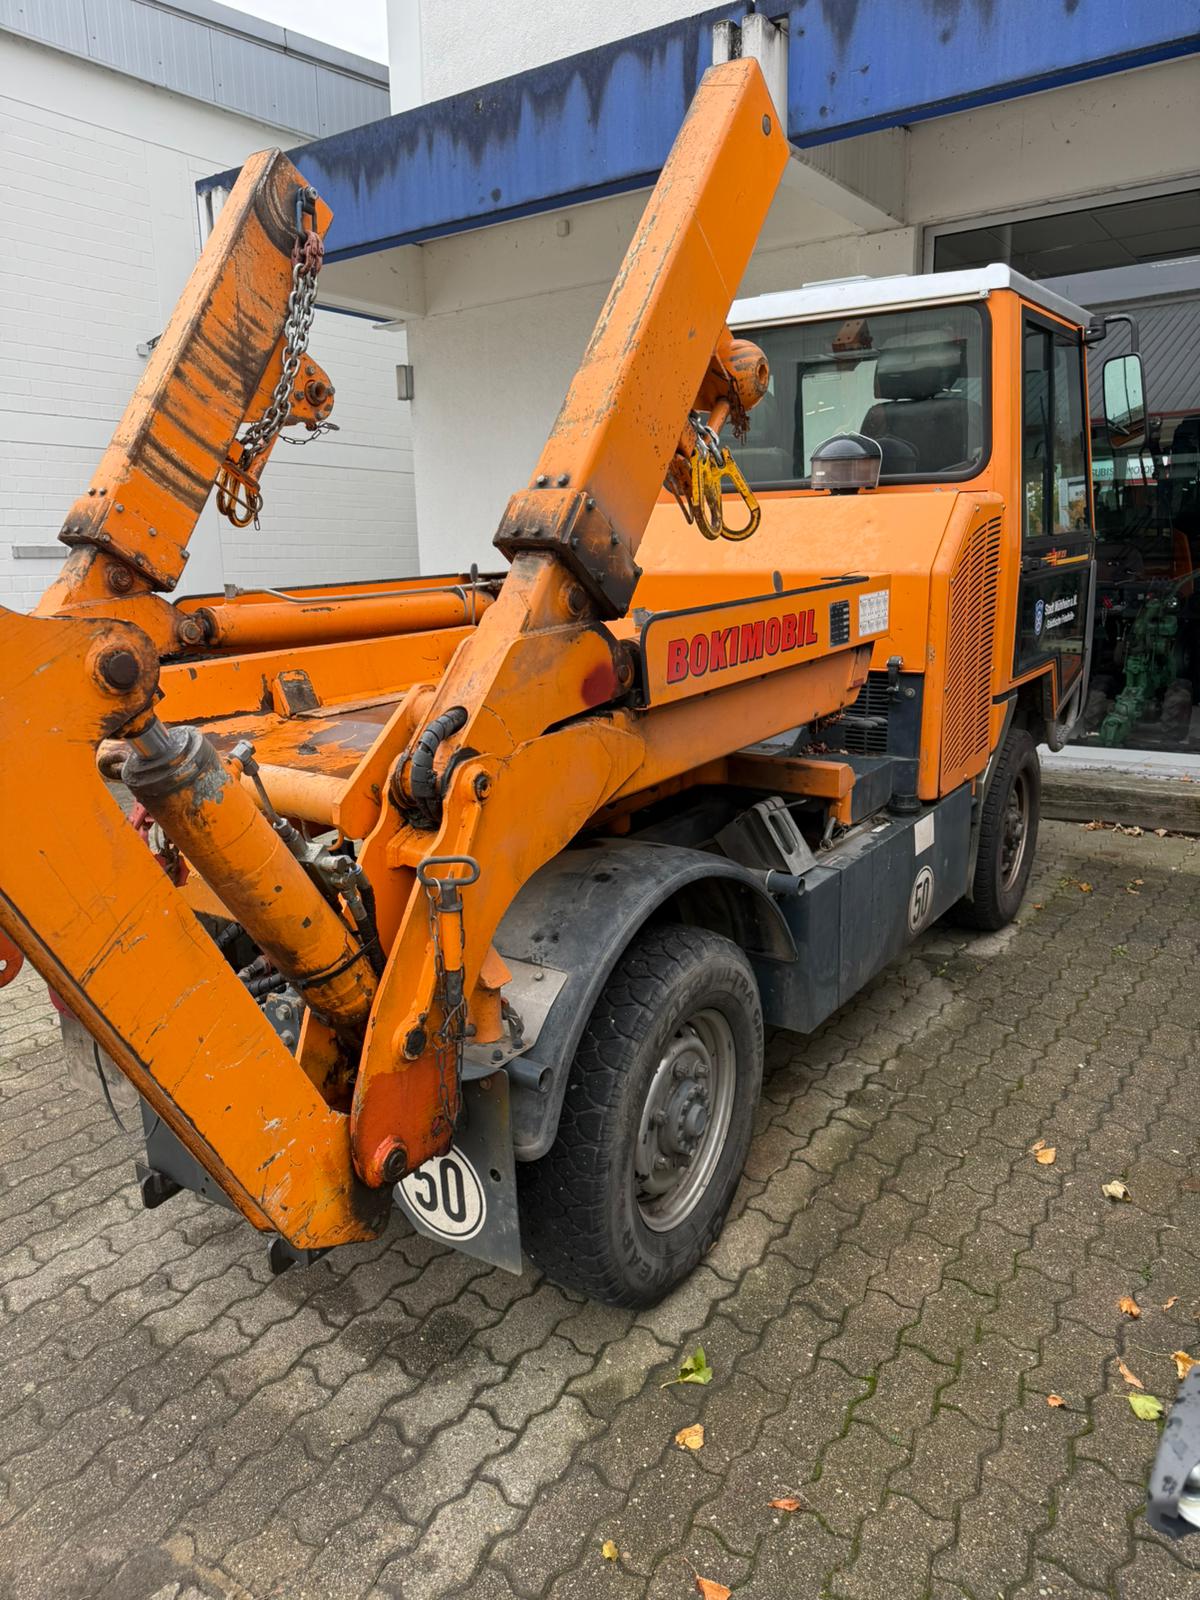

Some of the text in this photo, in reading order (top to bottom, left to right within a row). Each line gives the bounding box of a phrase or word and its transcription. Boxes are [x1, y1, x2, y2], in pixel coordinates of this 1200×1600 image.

[667, 609, 817, 684] BOKIMOBIL
[913, 877, 930, 924] 50
[413, 1158, 467, 1223] 50
